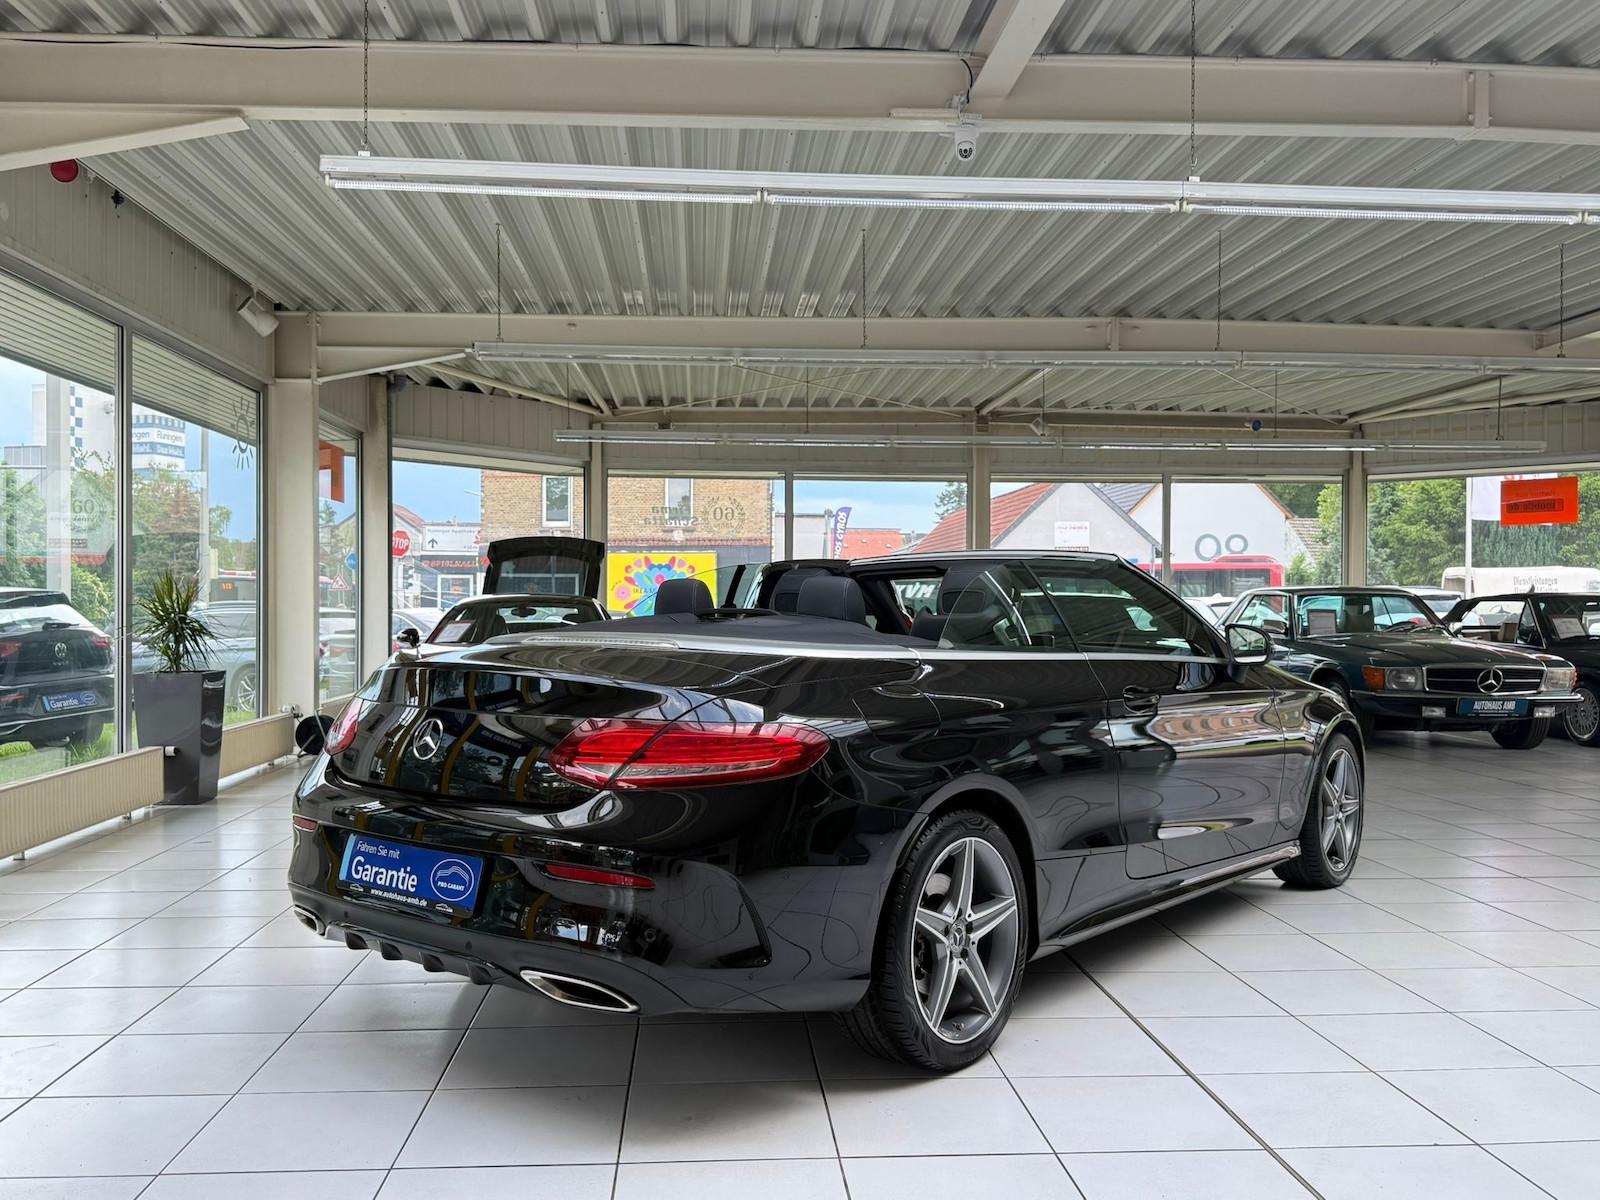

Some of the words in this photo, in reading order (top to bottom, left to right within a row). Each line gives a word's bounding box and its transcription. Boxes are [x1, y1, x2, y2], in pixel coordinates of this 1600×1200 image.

[836, 511, 848, 540] GYROS
[50, 698, 79, 708] Garantie
[1473, 701, 1502, 710] AUTOHAUS
[1503, 701, 1516, 710] AMB
[357, 841, 377, 854] Fahren
[378, 845, 388, 857] Sie
[388, 848, 400, 860] mit
[351, 855, 418, 893] Garantie
[370, 888, 428, 907] www.autohaus-amb.de
